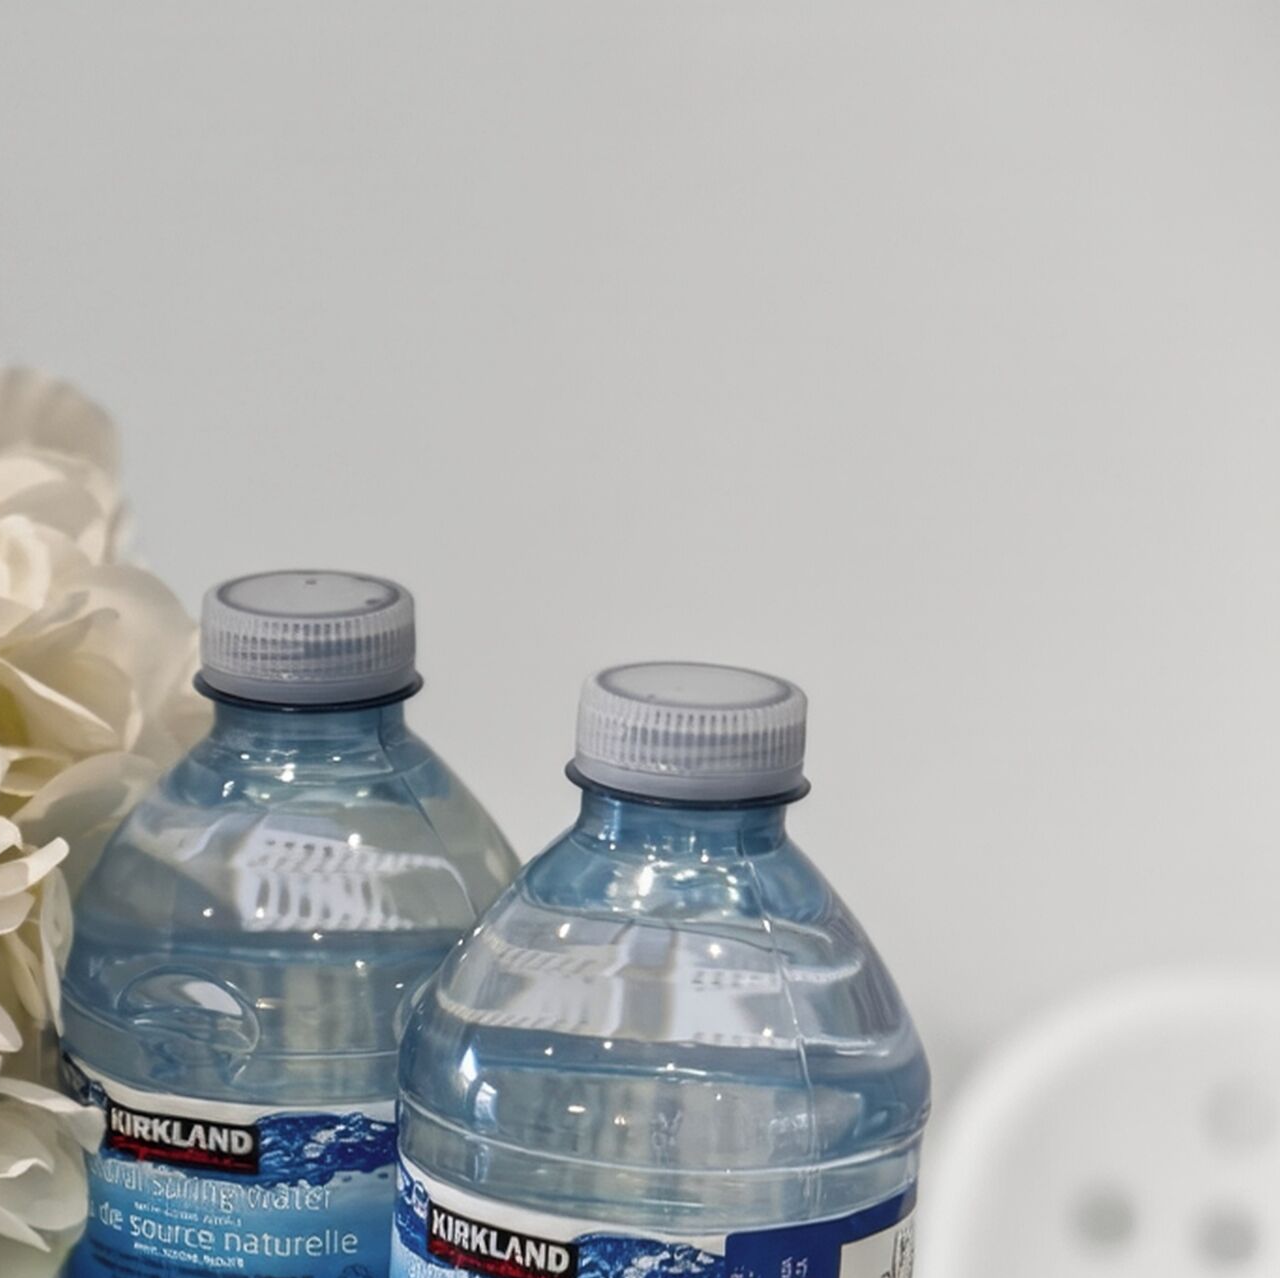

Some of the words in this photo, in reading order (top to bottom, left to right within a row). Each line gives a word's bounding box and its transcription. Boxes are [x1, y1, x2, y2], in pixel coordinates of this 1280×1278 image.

[111, 1107, 254, 1155] KIRKLAND
[128, 1214, 216, 1251] source
[223, 1229, 359, 1258] naturelle
[431, 1208, 571, 1274] KIRKLAND
